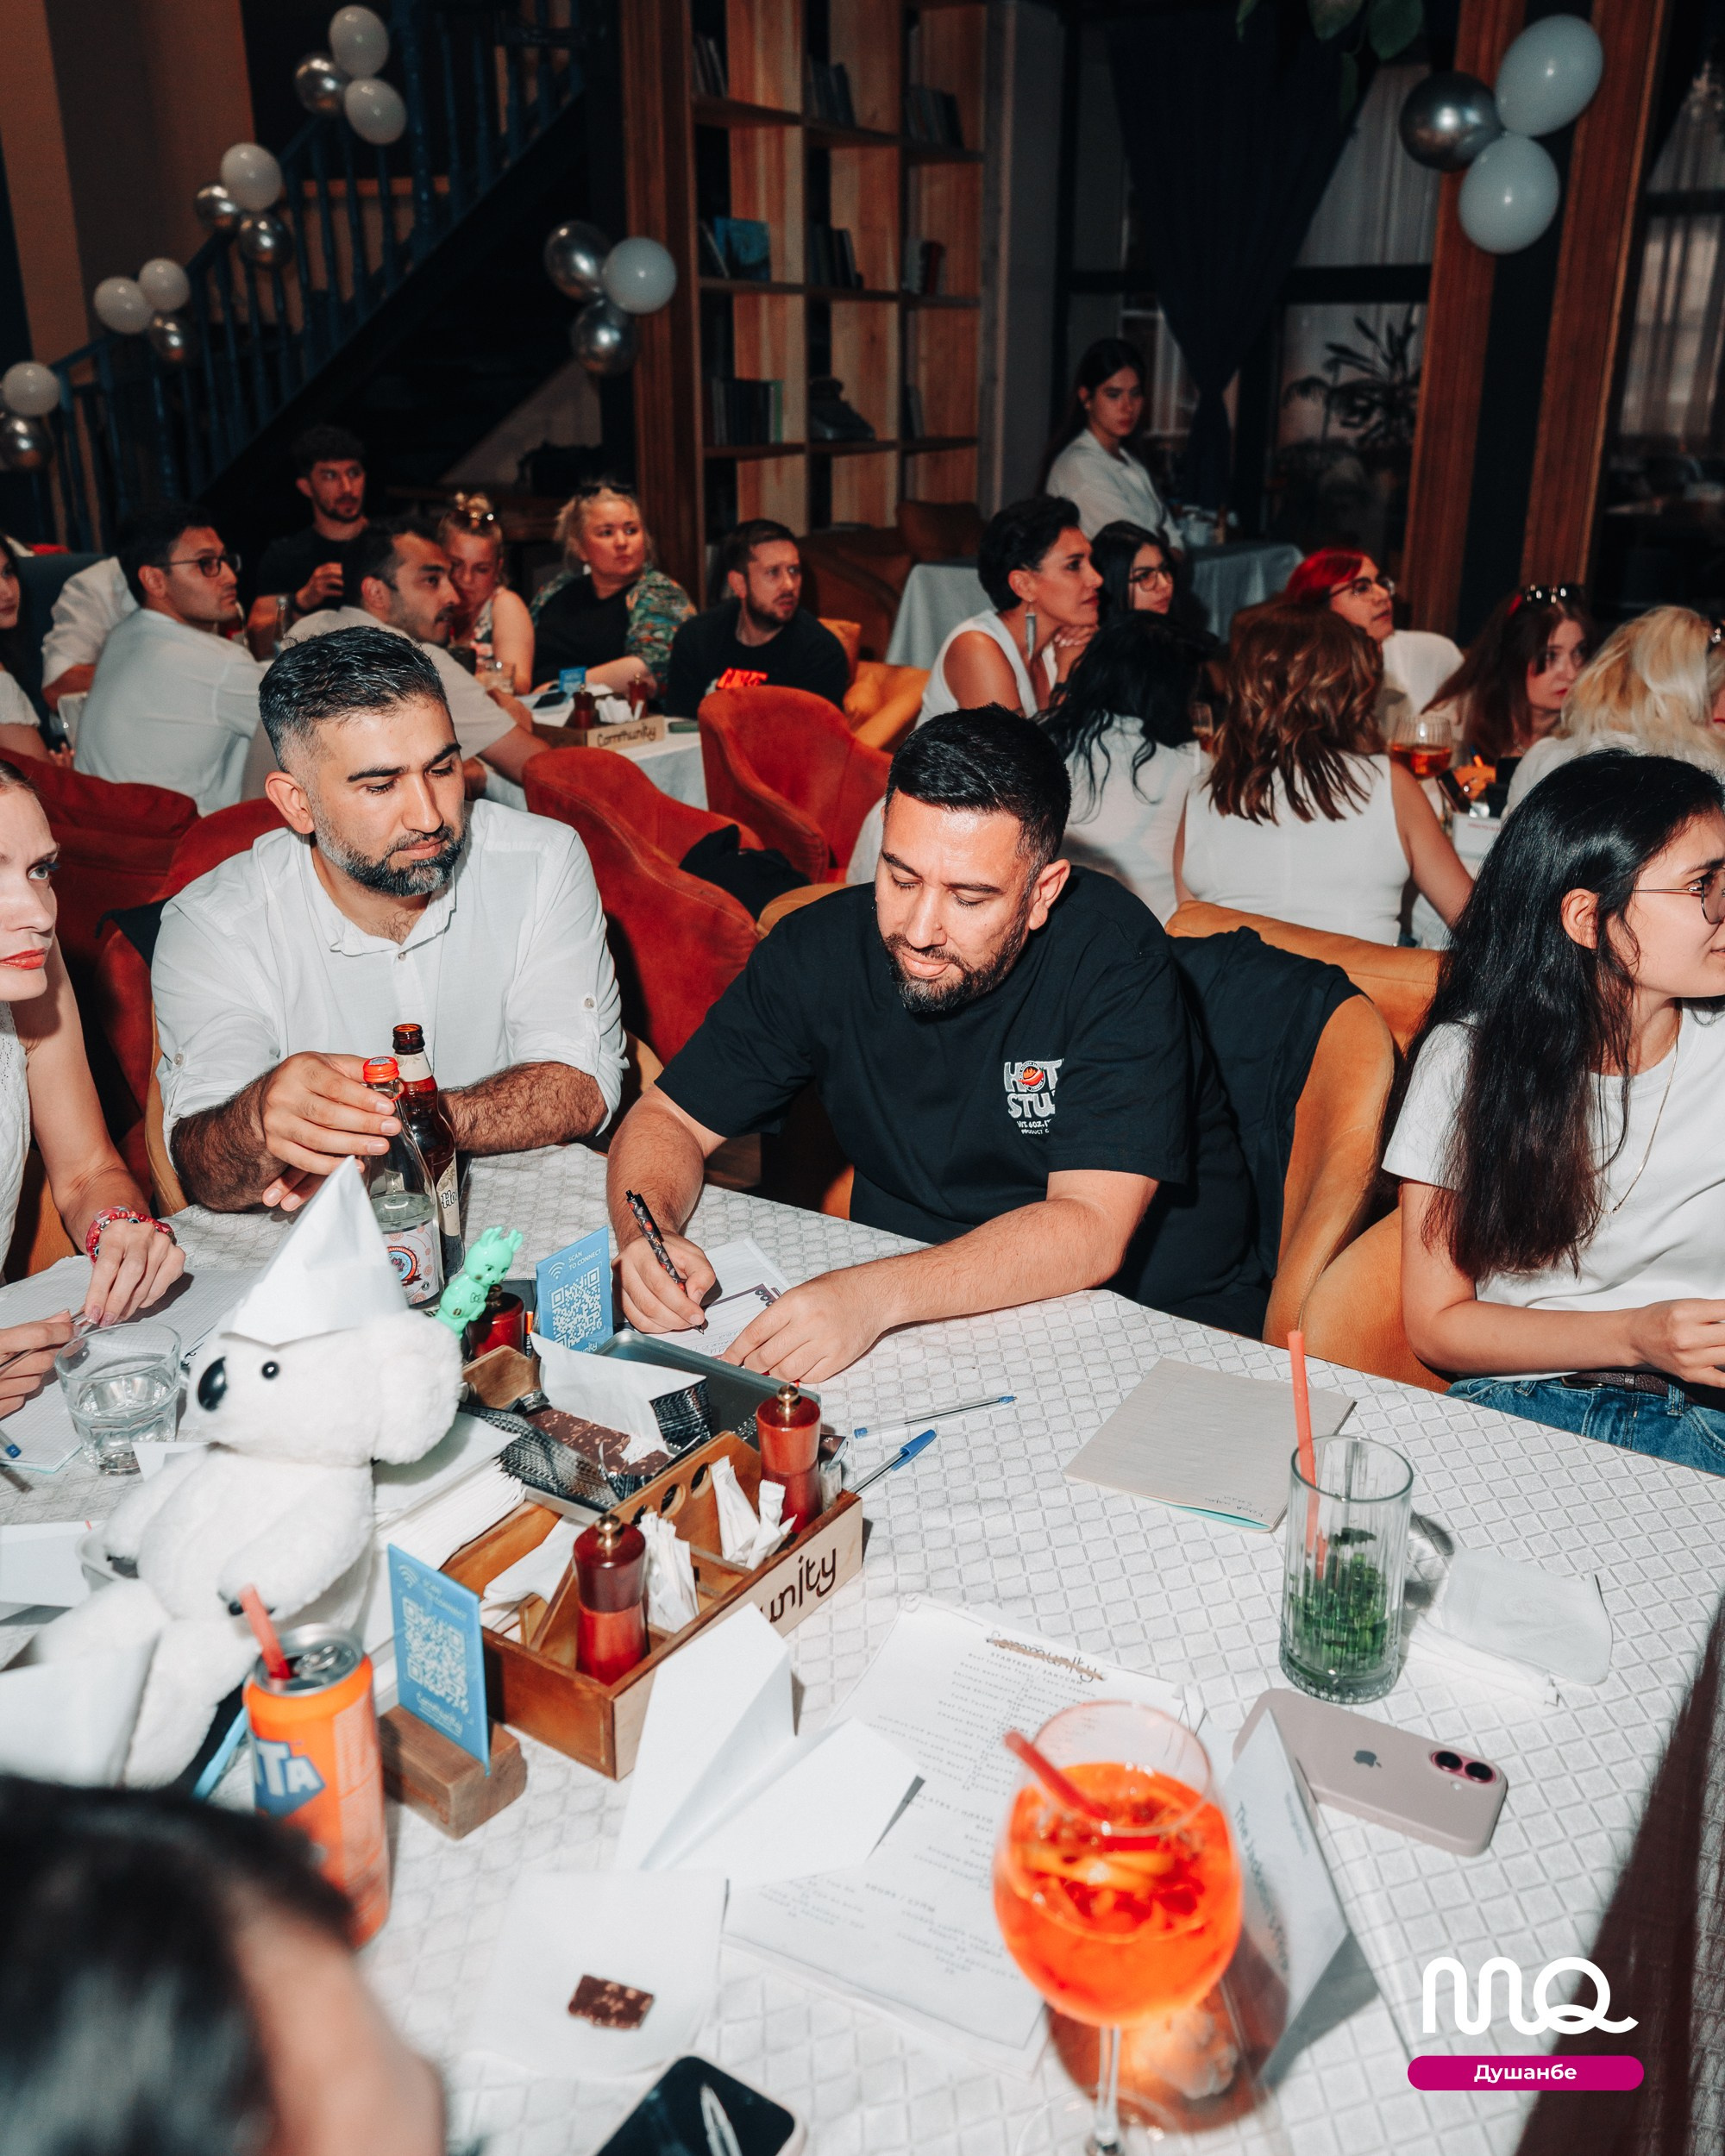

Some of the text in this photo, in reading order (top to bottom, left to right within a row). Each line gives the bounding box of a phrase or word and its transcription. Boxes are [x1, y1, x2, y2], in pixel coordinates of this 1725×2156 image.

[597, 723, 656, 748] Community
[1004, 1058, 1064, 1093] HOT
[1007, 1090, 1056, 1119] STU
[568, 1251, 582, 1263] SCAN
[568, 1248, 602, 1271] TO CONNECT
[760, 1548, 837, 1623] unity
